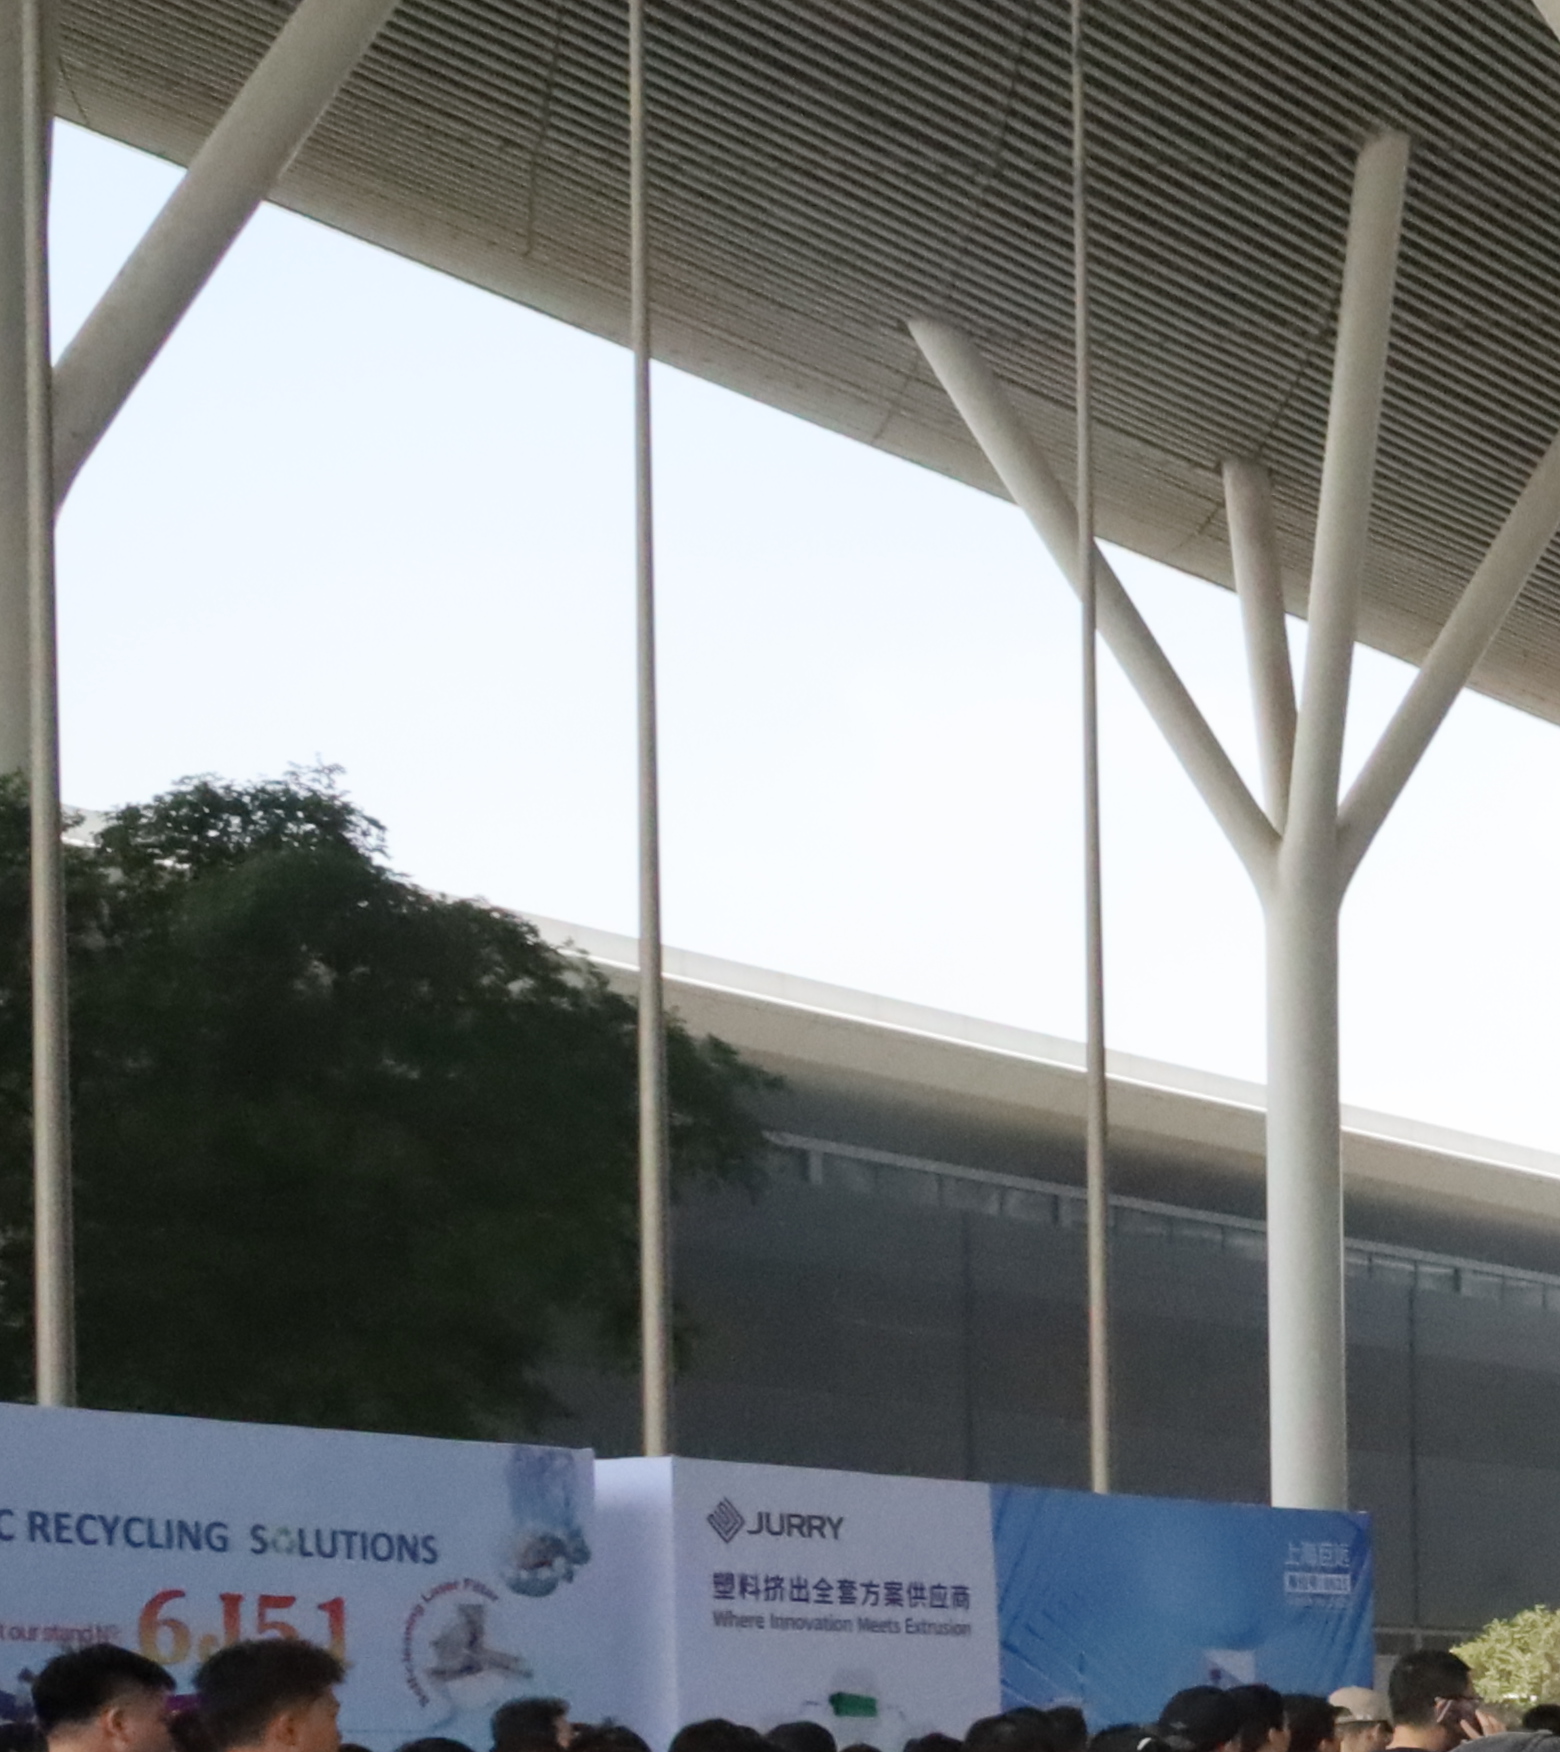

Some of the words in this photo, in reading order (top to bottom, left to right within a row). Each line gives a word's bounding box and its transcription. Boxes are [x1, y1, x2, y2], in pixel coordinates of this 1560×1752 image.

[27, 1510, 230, 1553] RECYCLING
[747, 1511, 845, 1541] JURRY
[712, 1571, 972, 1611] 塑料挤出全套方案供应商
[711, 1610, 765, 1629] Where
[770, 1612, 852, 1633] Innovation
[857, 1616, 901, 1634] Meets
[904, 1617, 972, 1637] Extrusion
